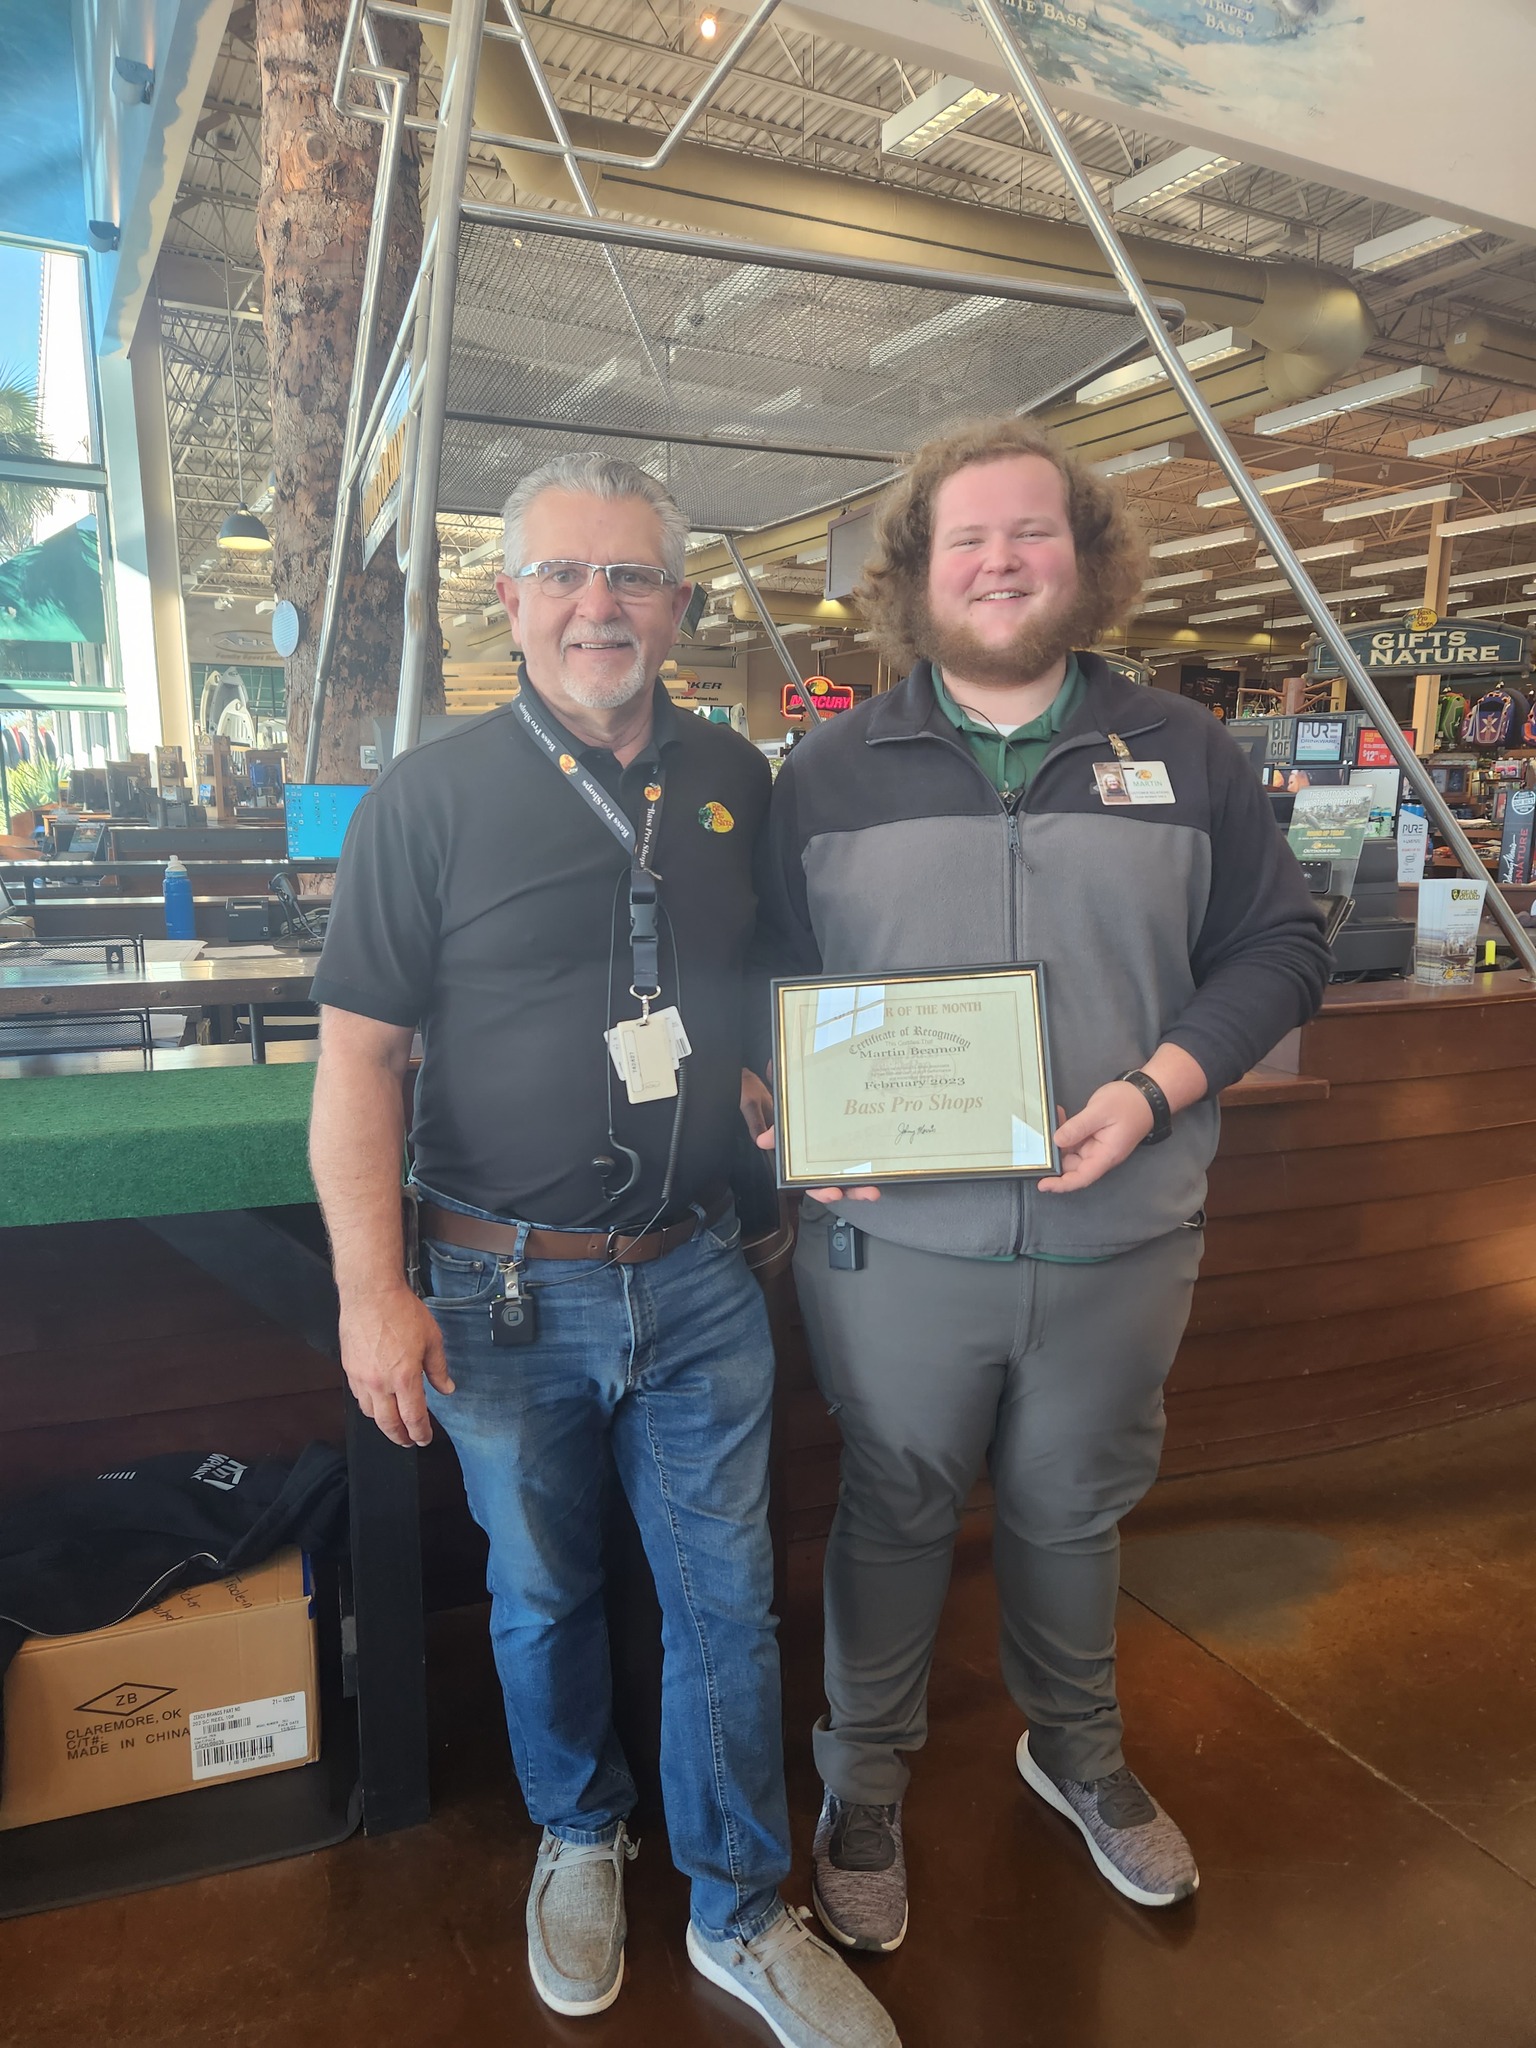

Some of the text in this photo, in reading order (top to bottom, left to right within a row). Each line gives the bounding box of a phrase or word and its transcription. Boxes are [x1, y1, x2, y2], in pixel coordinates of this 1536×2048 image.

[1043, 2, 1087, 30] BASS
[1206, 12, 1244, 38] BASS
[1371, 630, 1468, 650] GIFTS
[1369, 645, 1500, 667] NATURE
[688, 681, 722, 690] KER
[789, 694, 852, 709] MRCURY
[530, 720, 542, 736] Pro
[1301, 722, 1338, 739] PURE
[541, 734, 556, 752] Bass
[581, 780, 630, 839] Bass Pro Shops
[644, 827, 653, 843] Pro
[1402, 824, 1424, 834] PURE
[1515, 828, 1528, 884] GNATURE
[897, 1006, 912, 1017] OF
[917, 1004, 939, 1016] THE
[942, 1001, 982, 1014] MONTH
[849, 1025, 972, 1055] Certificate of Recognition
[860, 1046, 966, 1059] Martin Beamon
[865, 1077, 965, 1090] February 2023
[844, 1093, 983, 1116] Bass Pro Shops
[116, 1693, 138, 1706] ZB
[206, 1710, 223, 1719] BRANDS
[223, 1707, 234, 1716] PART
[66, 1708, 182, 1740] CLAREMORE, OK
[66, 1735, 104, 1750] C/T#:
[67, 1727, 191, 1760] MADE IN CHINA
